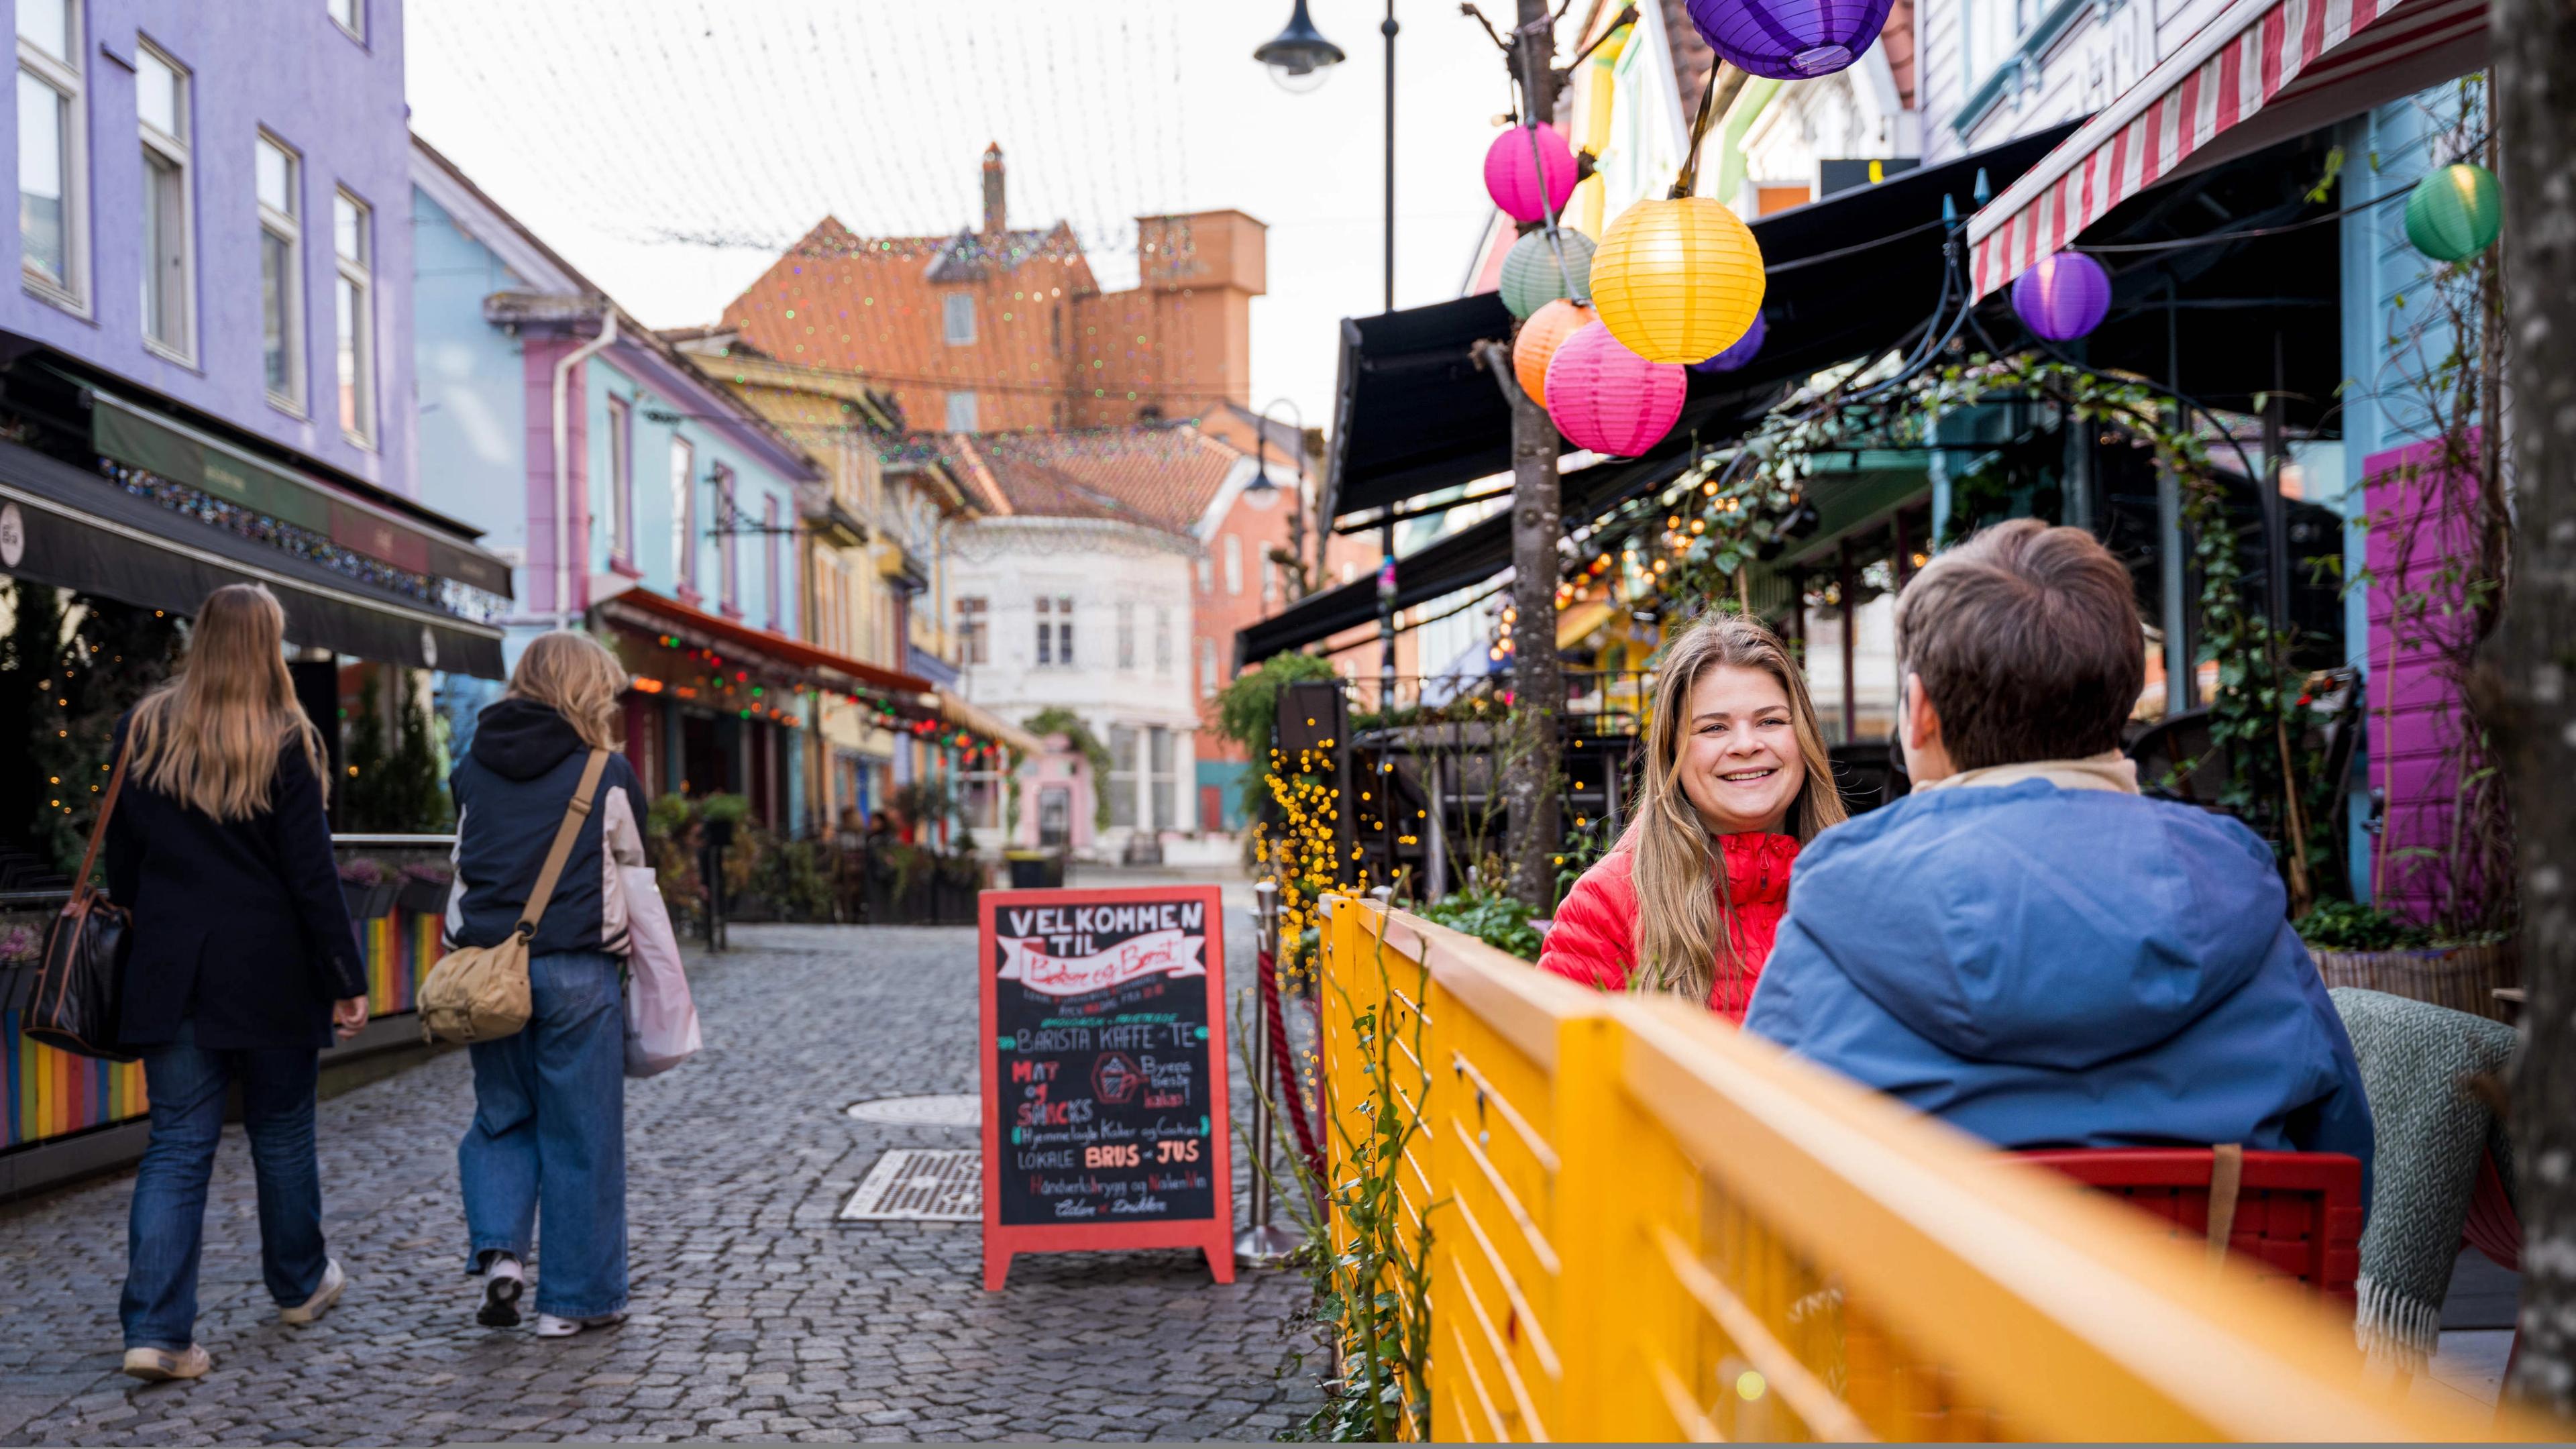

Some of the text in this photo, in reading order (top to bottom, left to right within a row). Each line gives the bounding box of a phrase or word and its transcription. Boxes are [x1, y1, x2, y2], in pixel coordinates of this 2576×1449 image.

[1009, 902, 1204, 937] VELKOMMEN
[1049, 935, 1099, 956] TIL
[1016, 1027, 1091, 1054] BARISTA
[1099, 1023, 1156, 1051] KAFFE
[1172, 1022, 1197, 1048] TE
[1012, 1060, 1060, 1083] MAT
[1140, 1055, 1193, 1075] Byens
[1024, 1083, 1049, 1104] og
[1150, 1075, 1191, 1089] beste
[1017, 1098, 1093, 1126] SNACKS
[1100, 1118, 1136, 1139] Kaker
[1140, 1127, 1158, 1140] og
[1157, 1115, 1199, 1136] Cookies
[1017, 1149, 1075, 1170] LOKALE
[1085, 1143, 1140, 1169] BRUS
[1157, 1139, 1200, 1165] JUS
[1131, 1180, 1147, 1196] og
